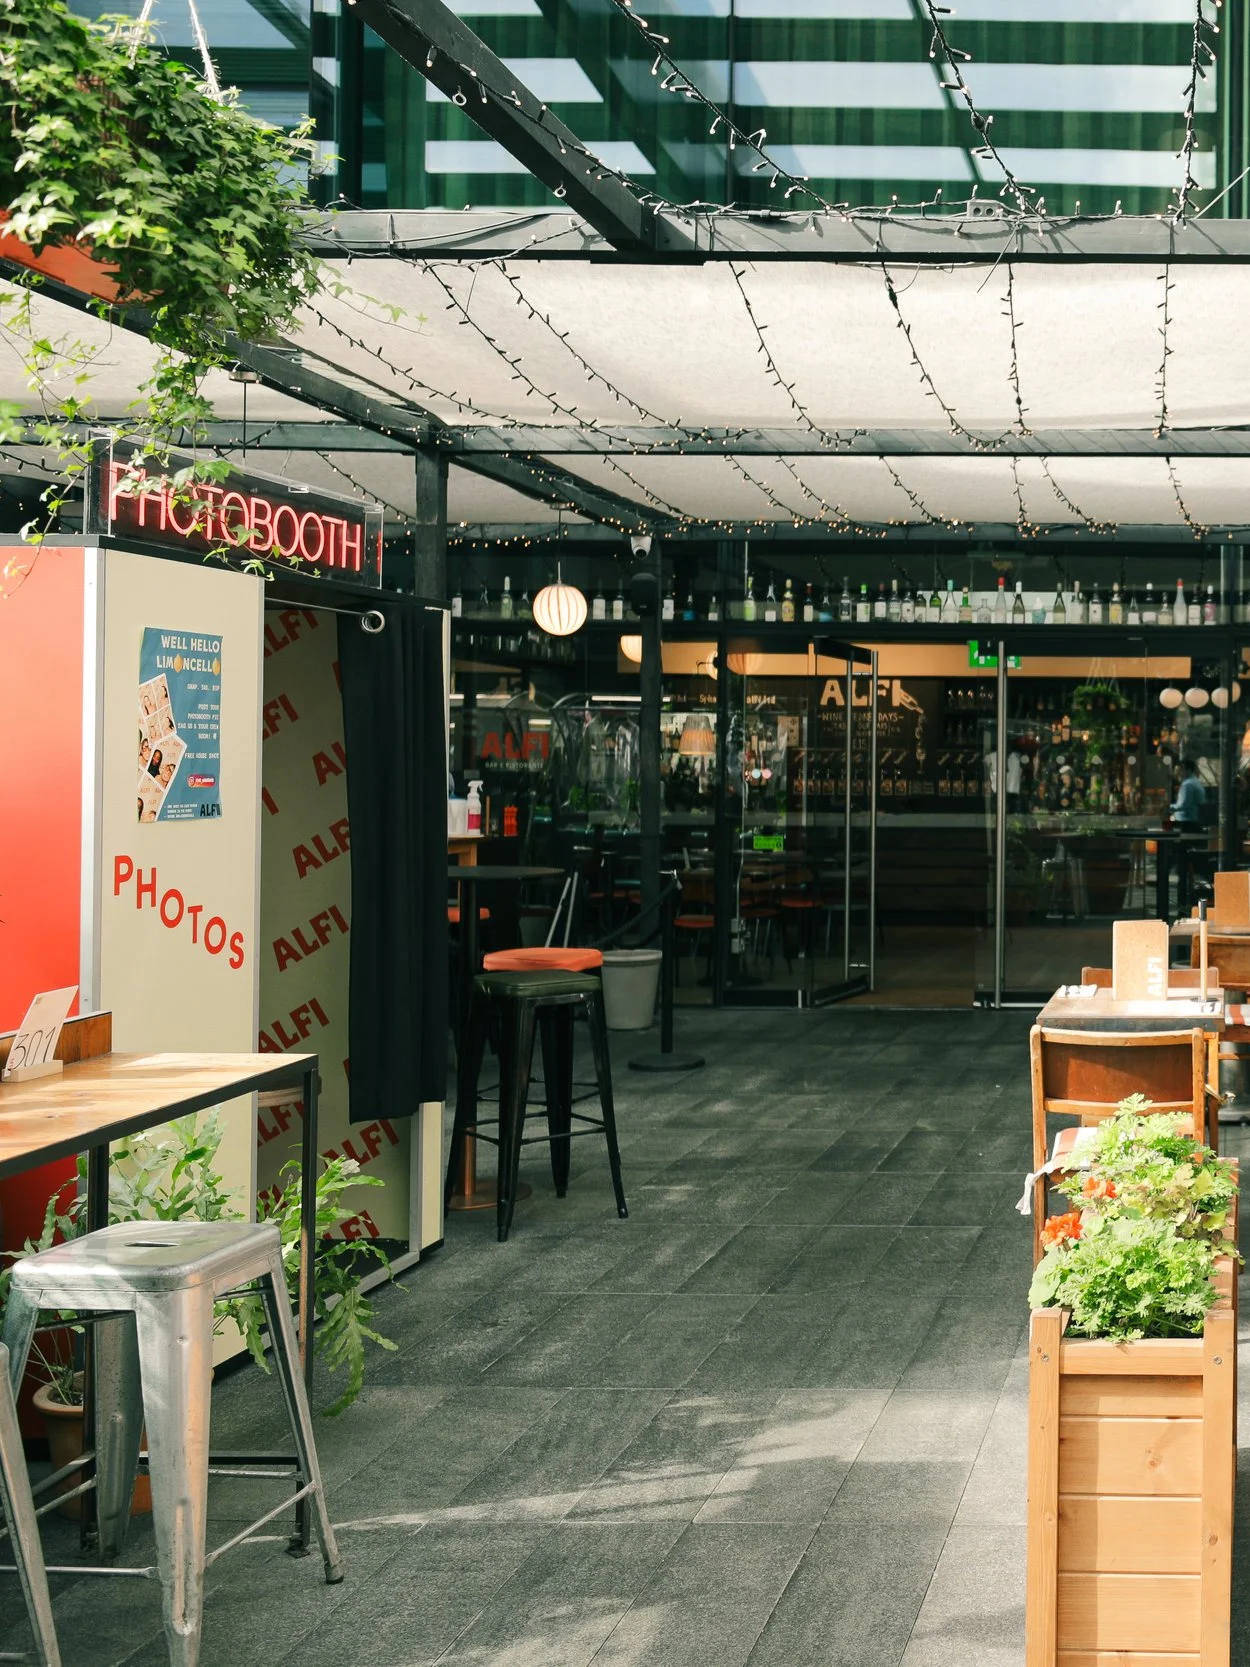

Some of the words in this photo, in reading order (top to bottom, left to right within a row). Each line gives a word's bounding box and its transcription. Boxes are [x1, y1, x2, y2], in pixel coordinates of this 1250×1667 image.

[111, 461, 362, 572] PHOTOBOOTH
[161, 635, 188, 650] WELL
[190, 638, 220, 653] HELLO
[264, 610, 319, 658] LFI
[820, 680, 901, 706] ALFI
[263, 694, 299, 741] FI
[481, 731, 549, 760] ALFI
[292, 817, 350, 879] ALF
[114, 855, 244, 969] PHOTOS
[272, 904, 350, 972] ALFI
[1147, 956, 1163, 997] ALFI
[7, 1026, 57, 1071] 301
[258, 998, 330, 1053] ALFI
